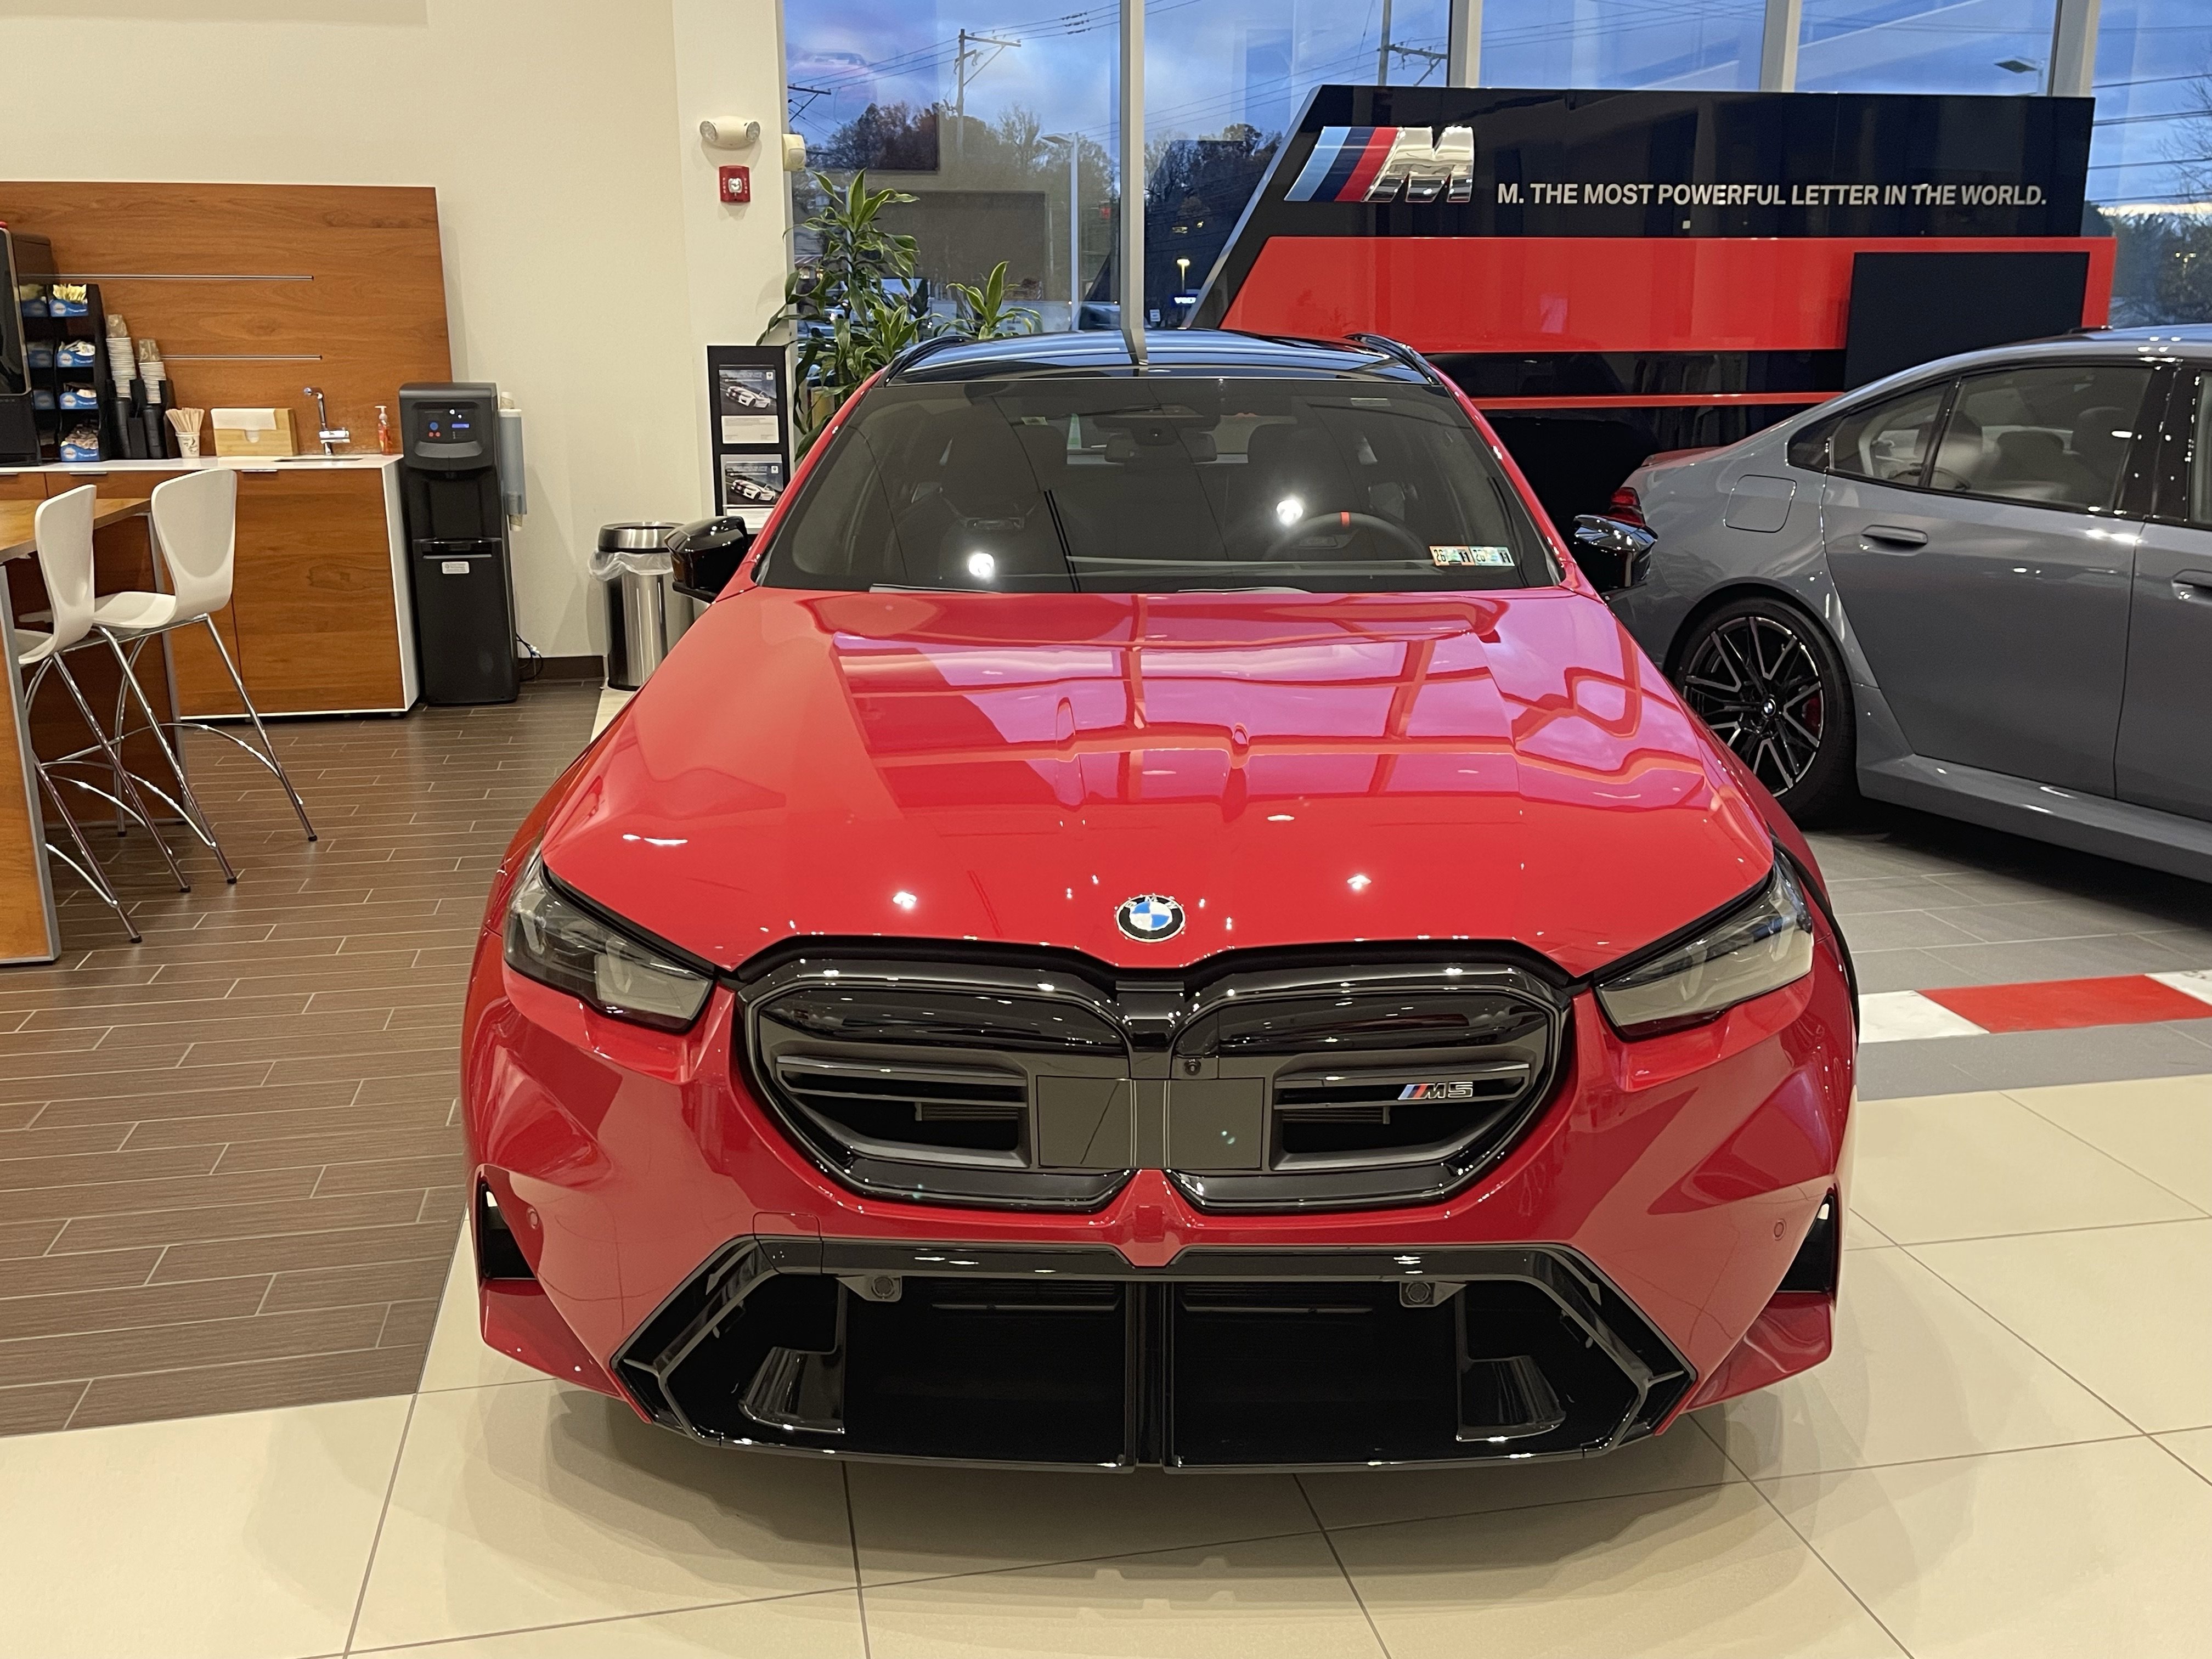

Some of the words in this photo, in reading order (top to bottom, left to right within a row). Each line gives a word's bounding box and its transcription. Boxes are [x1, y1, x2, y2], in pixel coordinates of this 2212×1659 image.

[1361, 126, 1475, 203] M
[1498, 183, 1524, 204] M.
[1530, 183, 1578, 204] THE
[1584, 183, 1654, 205] MOST
[1658, 184, 1786, 205] POWERFUL
[1792, 185, 1878, 205] LETTER
[1884, 185, 1906, 205] IN
[1911, 183, 1956, 205] THE
[1961, 185, 2046, 205] WORLD.
[1434, 549, 1447, 562] 26
[1458, 552, 1471, 562] 11
[1499, 552, 1512, 563] 11
[1419, 1081, 1474, 1099] M5
